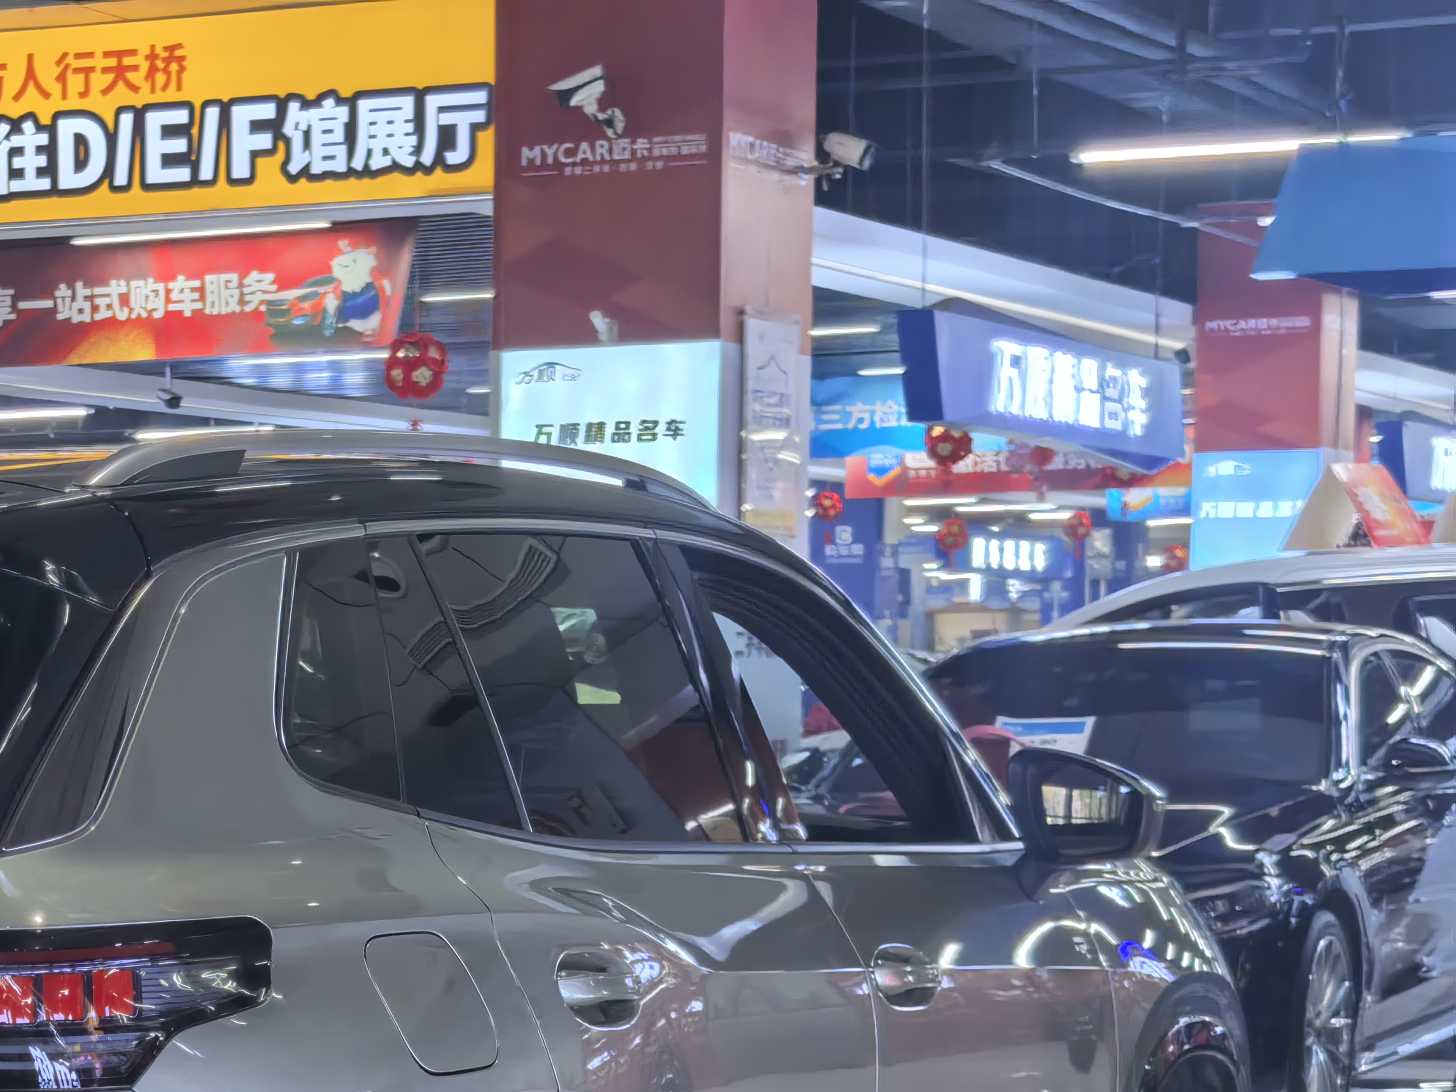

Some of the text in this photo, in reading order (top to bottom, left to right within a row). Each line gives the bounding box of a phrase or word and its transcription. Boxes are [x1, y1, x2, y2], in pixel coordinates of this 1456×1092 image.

[533, 418, 687, 448] 万顺精品名车
